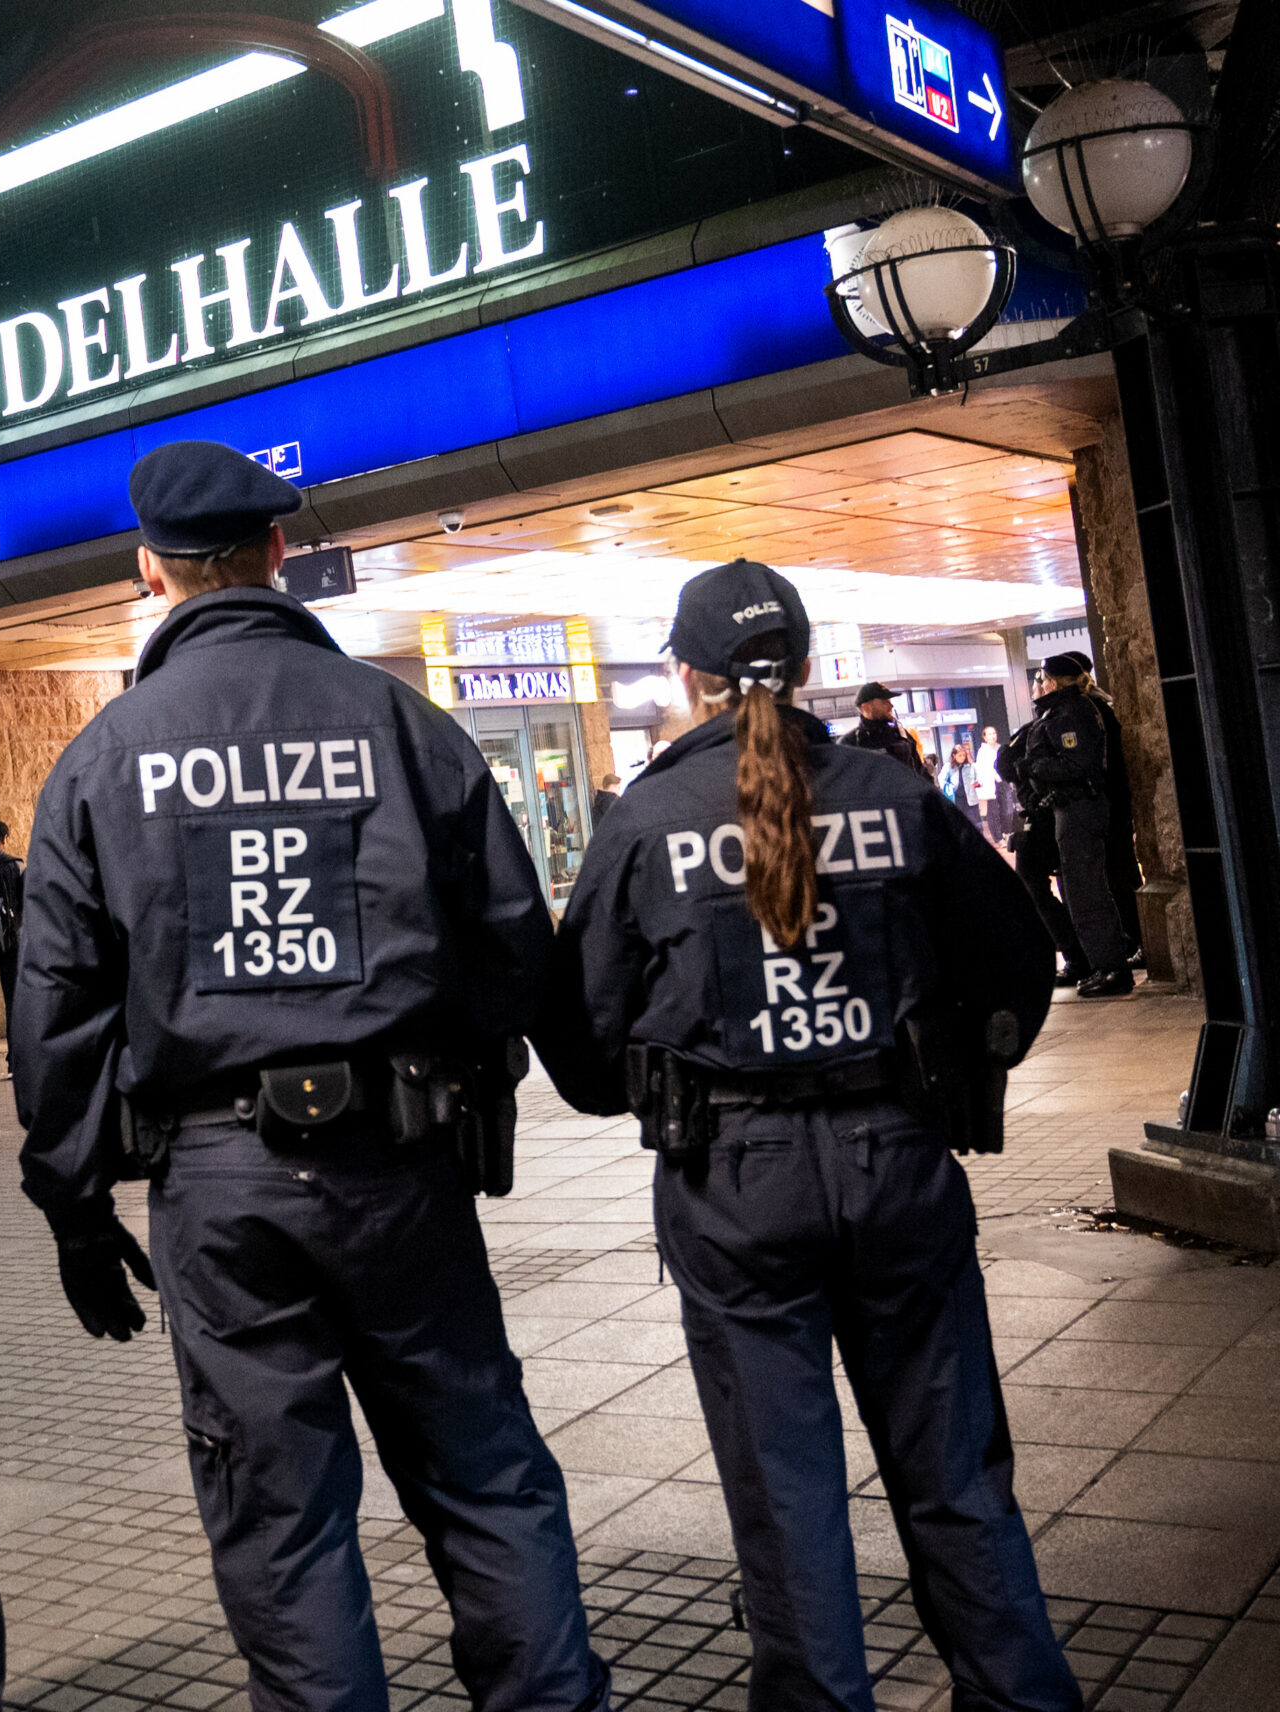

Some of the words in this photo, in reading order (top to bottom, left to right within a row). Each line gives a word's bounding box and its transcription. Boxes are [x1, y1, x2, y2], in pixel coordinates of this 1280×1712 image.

[931, 92, 949, 120] U2
[973, 357, 990, 373] 57
[460, 672, 513, 700] Tabak
[515, 670, 570, 698] JONAS
[138, 739, 376, 814] POLIZEI
[230, 827, 308, 876] BP
[666, 808, 906, 894] POZEI
[230, 877, 315, 928] RZ
[760, 902, 838, 954] P
[212, 926, 337, 978] 1350
[762, 951, 849, 1005] RZ
[749, 997, 872, 1054] 1350
